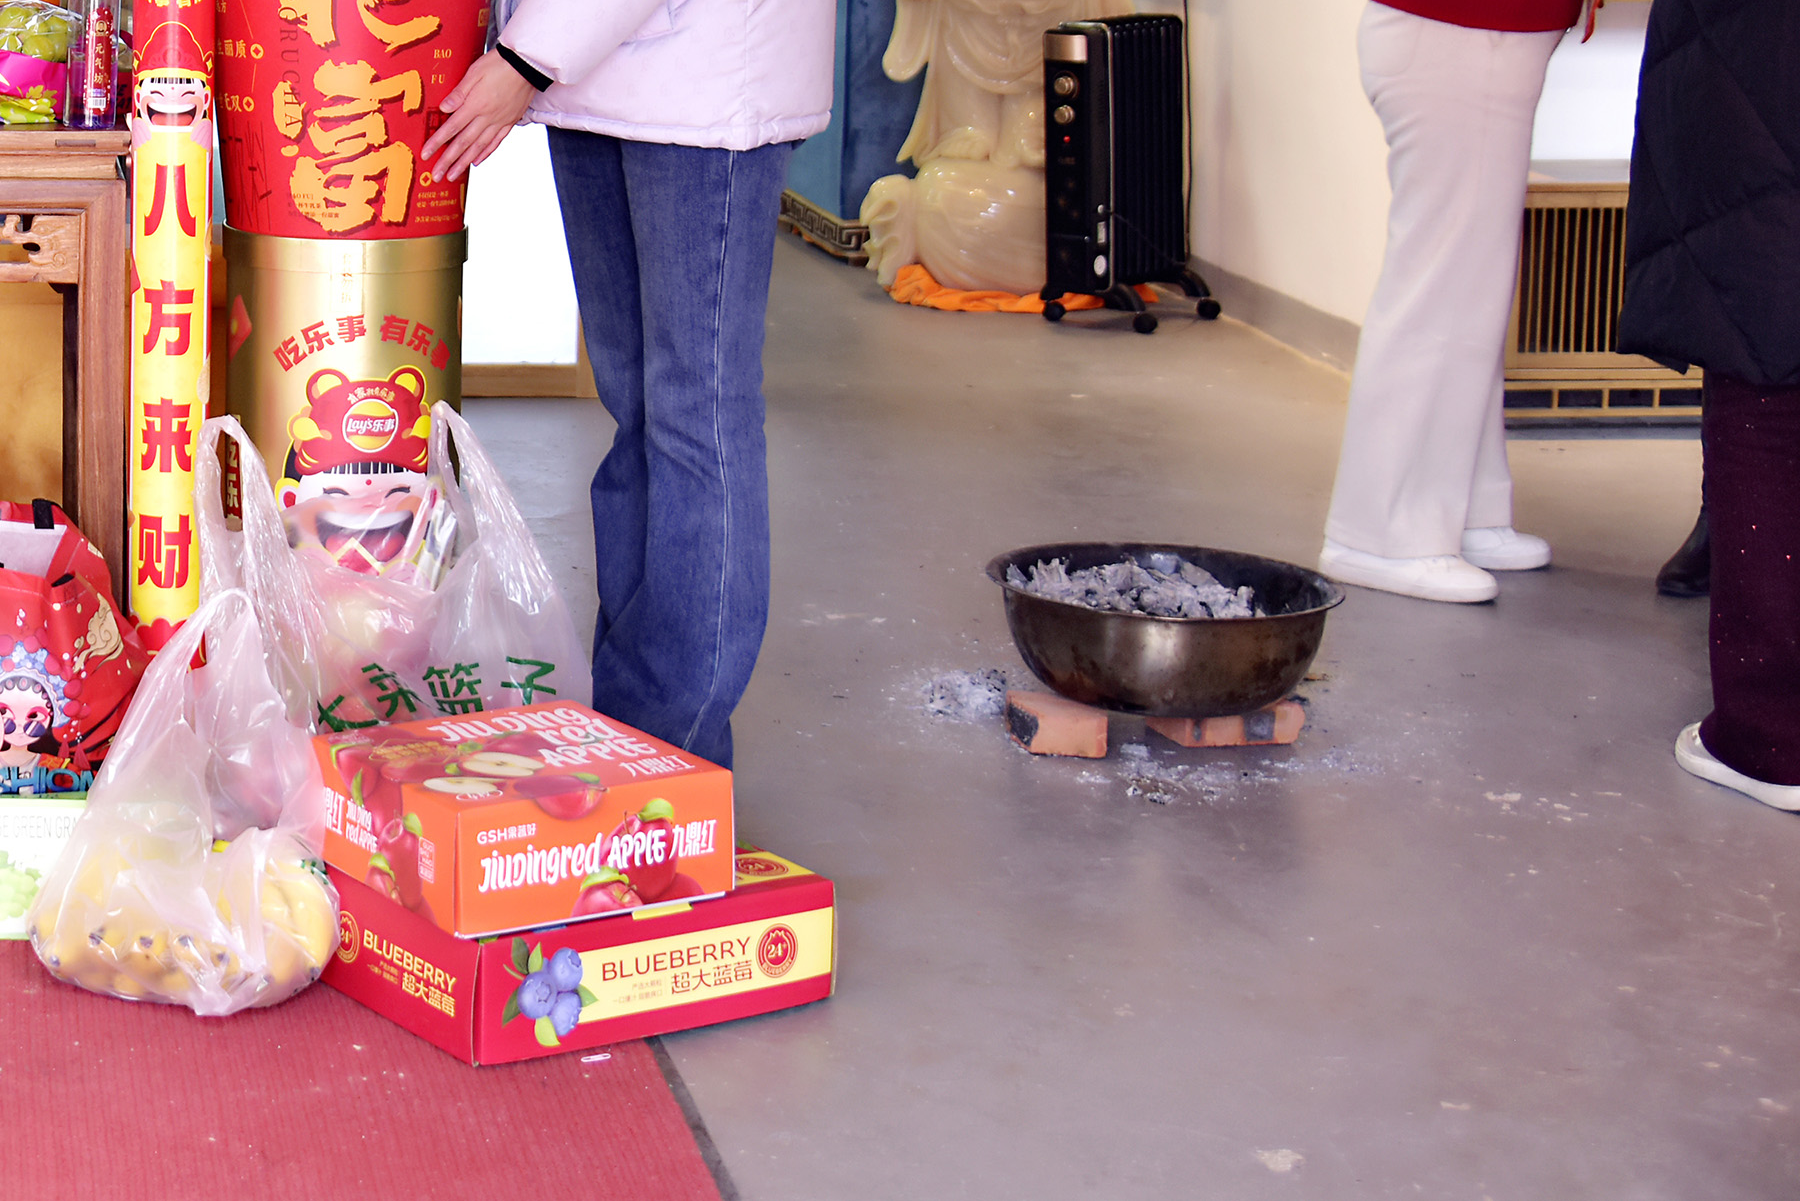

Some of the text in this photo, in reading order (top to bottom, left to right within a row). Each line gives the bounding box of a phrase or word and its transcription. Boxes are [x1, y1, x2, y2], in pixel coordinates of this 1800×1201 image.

[434, 49, 452, 59] BAO
[431, 74, 446, 84] FU
[273, 314, 451, 372] 吃乐事 有乐事
[137, 162, 201, 589] 八方来财
[347, 417, 396, 435] Lay's乐事
[620, 755, 696, 777] 九鼎红
[606, 829, 667, 870] APPLE
[669, 819, 717, 859] 九鼎红
[363, 929, 457, 993] BLUEBERRY
[602, 936, 751, 981] BLUEBERRY
[671, 959, 753, 995] 超大蓝莓
[401, 971, 456, 1018] 超大蓝莓
